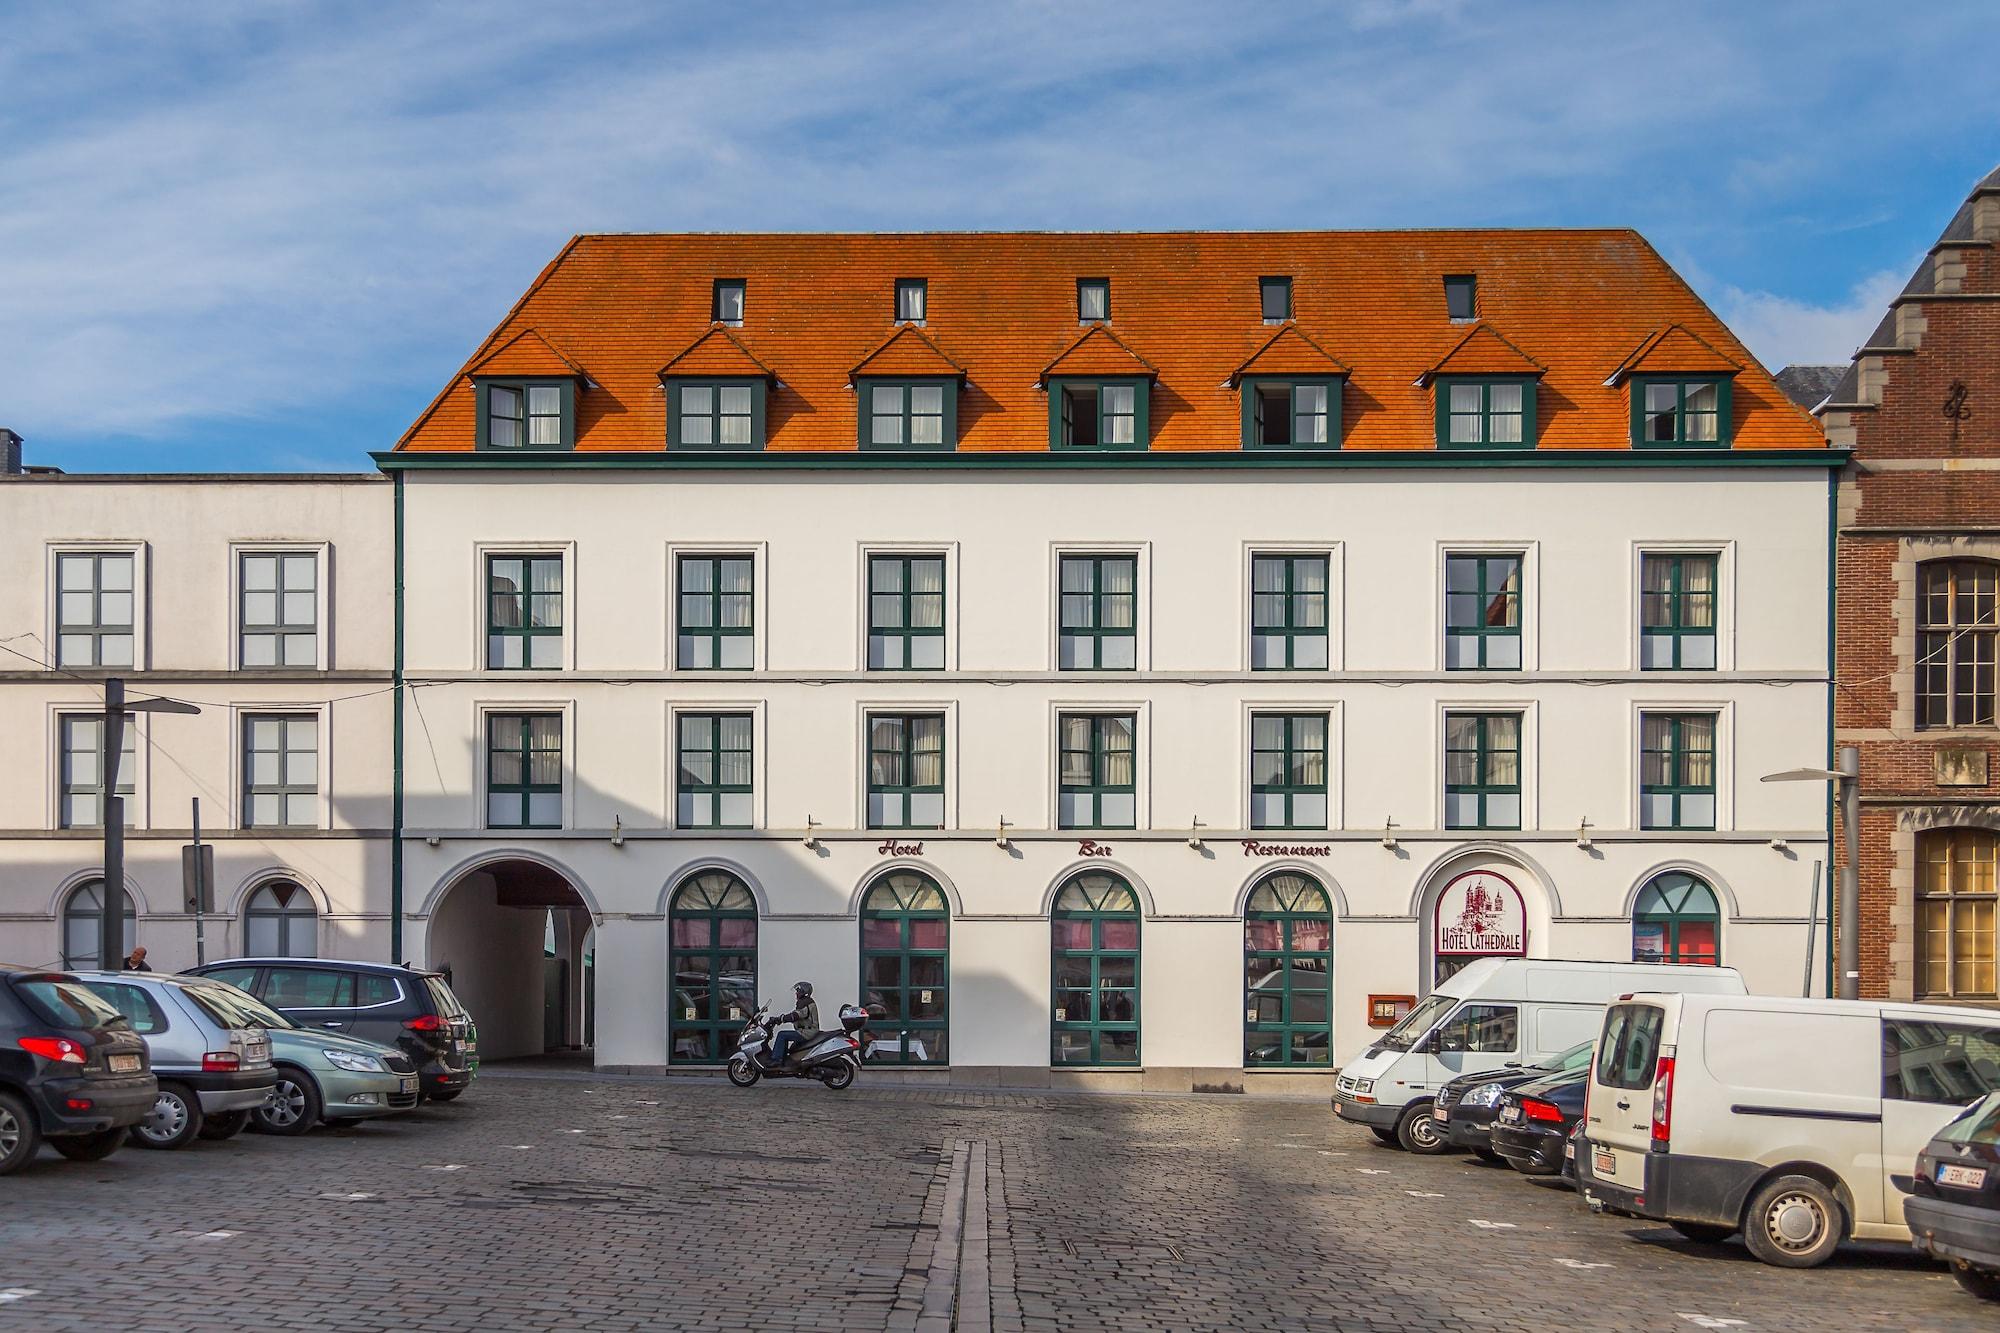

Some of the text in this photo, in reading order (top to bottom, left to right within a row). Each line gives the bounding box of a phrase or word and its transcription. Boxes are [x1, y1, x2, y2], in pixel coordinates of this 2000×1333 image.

[878, 838, 924, 857] Hotel
[1078, 838, 1112, 857] Bar
[1241, 838, 1331, 857] Restaurant
[1442, 927, 1520, 950] HOTEL CATHEDRALE
